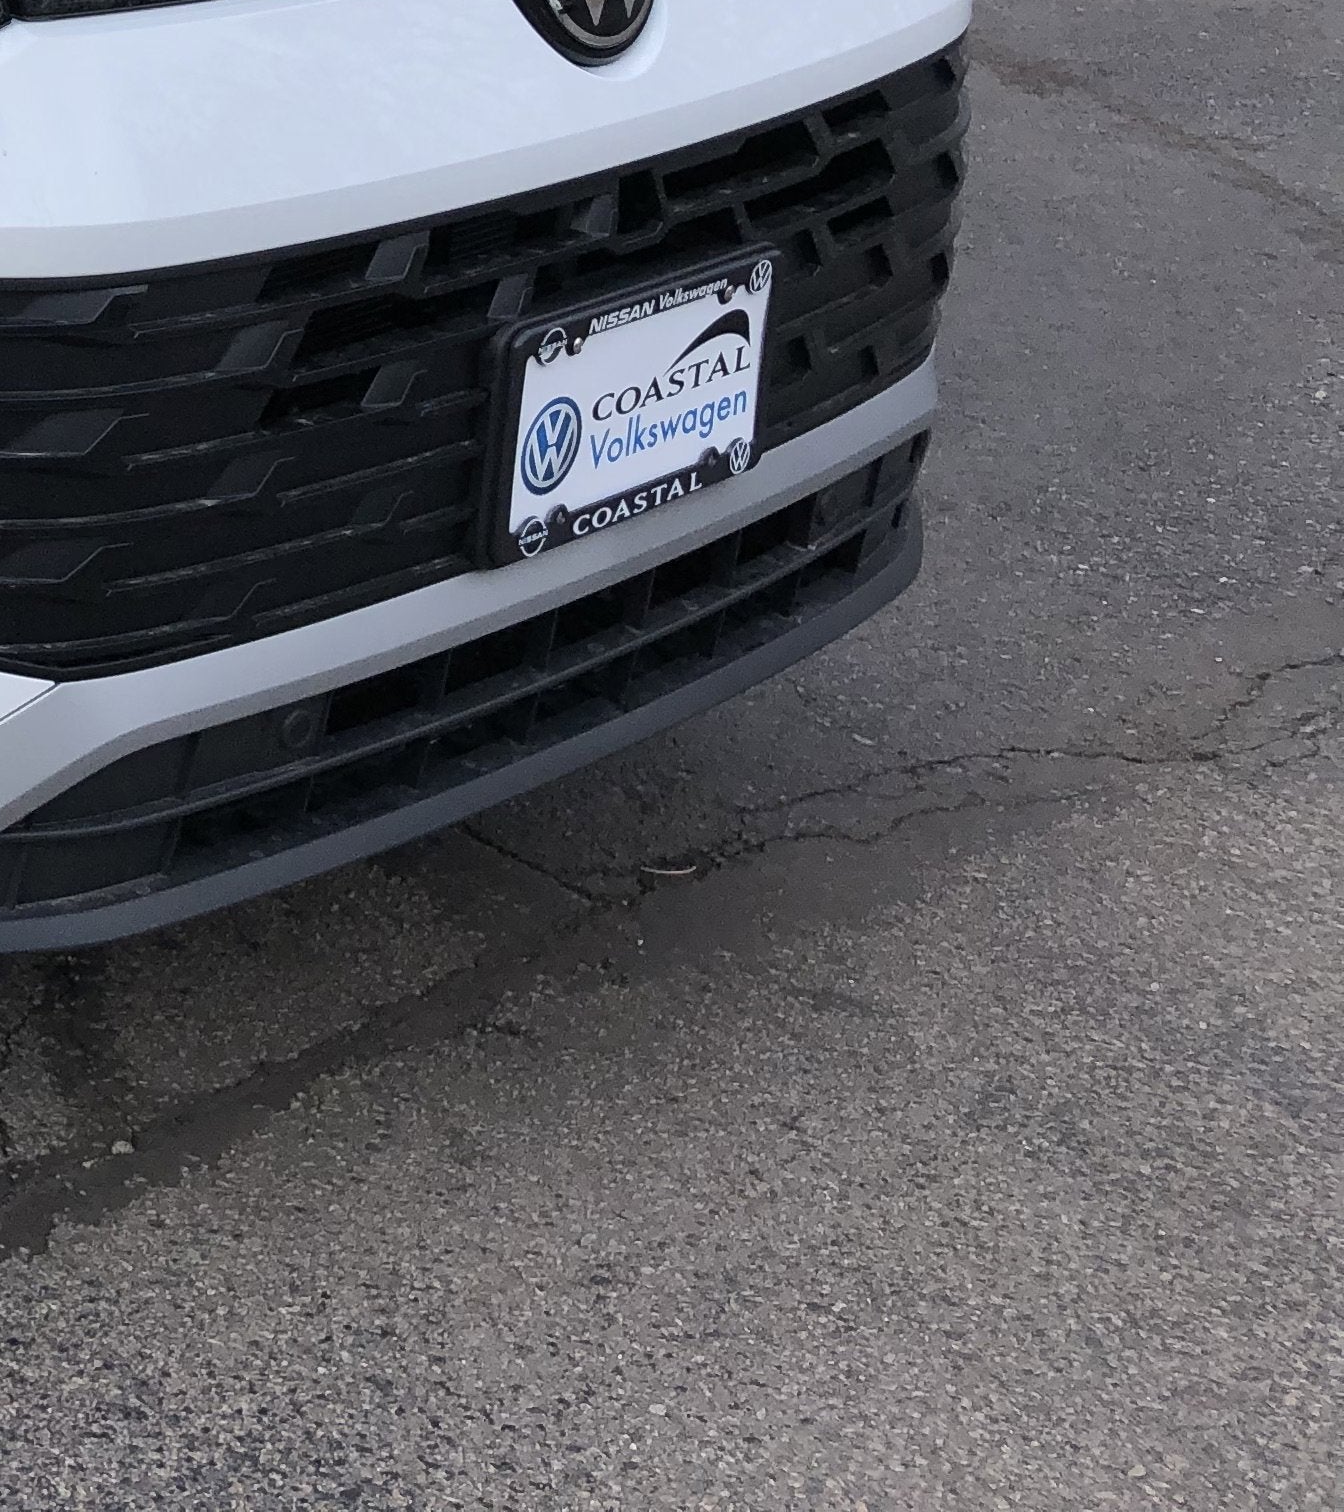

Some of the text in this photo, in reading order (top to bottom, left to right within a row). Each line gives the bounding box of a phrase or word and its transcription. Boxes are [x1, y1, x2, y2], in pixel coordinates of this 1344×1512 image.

[589, 278, 728, 334] NISSAN Volkswagen
[592, 346, 750, 421] COASTAL
[590, 390, 747, 469] Volkswagen
[572, 472, 702, 535] COASTAL
